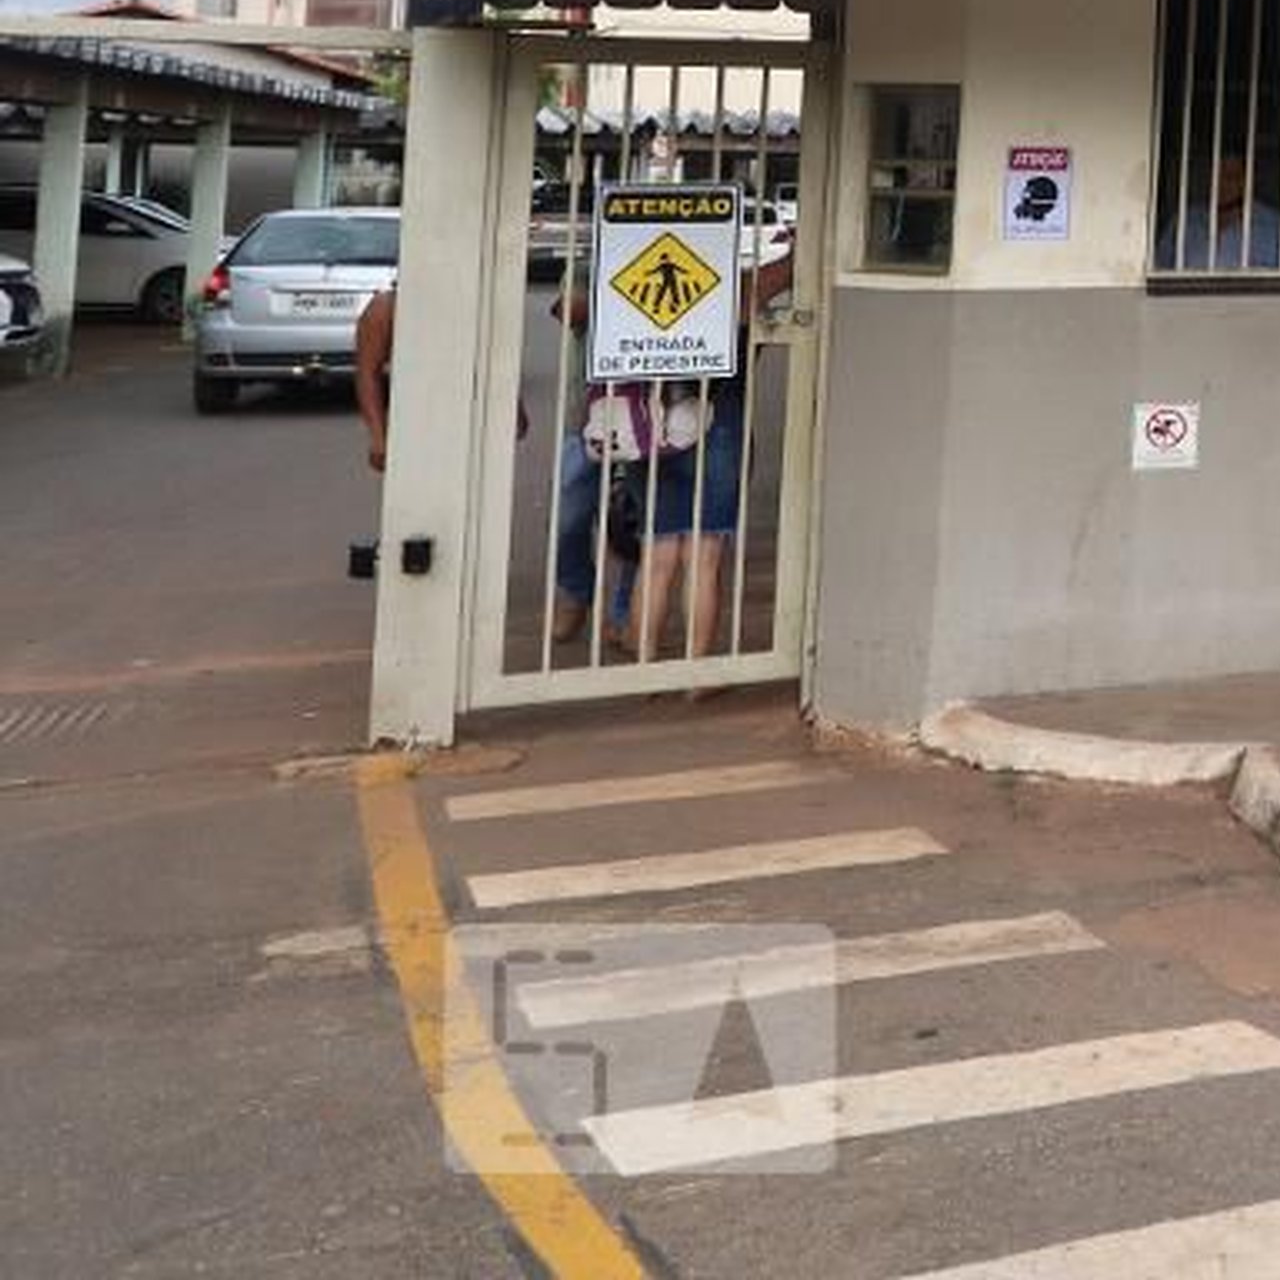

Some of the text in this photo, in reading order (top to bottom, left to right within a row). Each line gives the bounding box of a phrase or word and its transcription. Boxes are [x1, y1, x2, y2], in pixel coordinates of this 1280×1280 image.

[619, 336, 707, 352] ENTRADA
[598, 354, 726, 372] DE PEDESTRE
